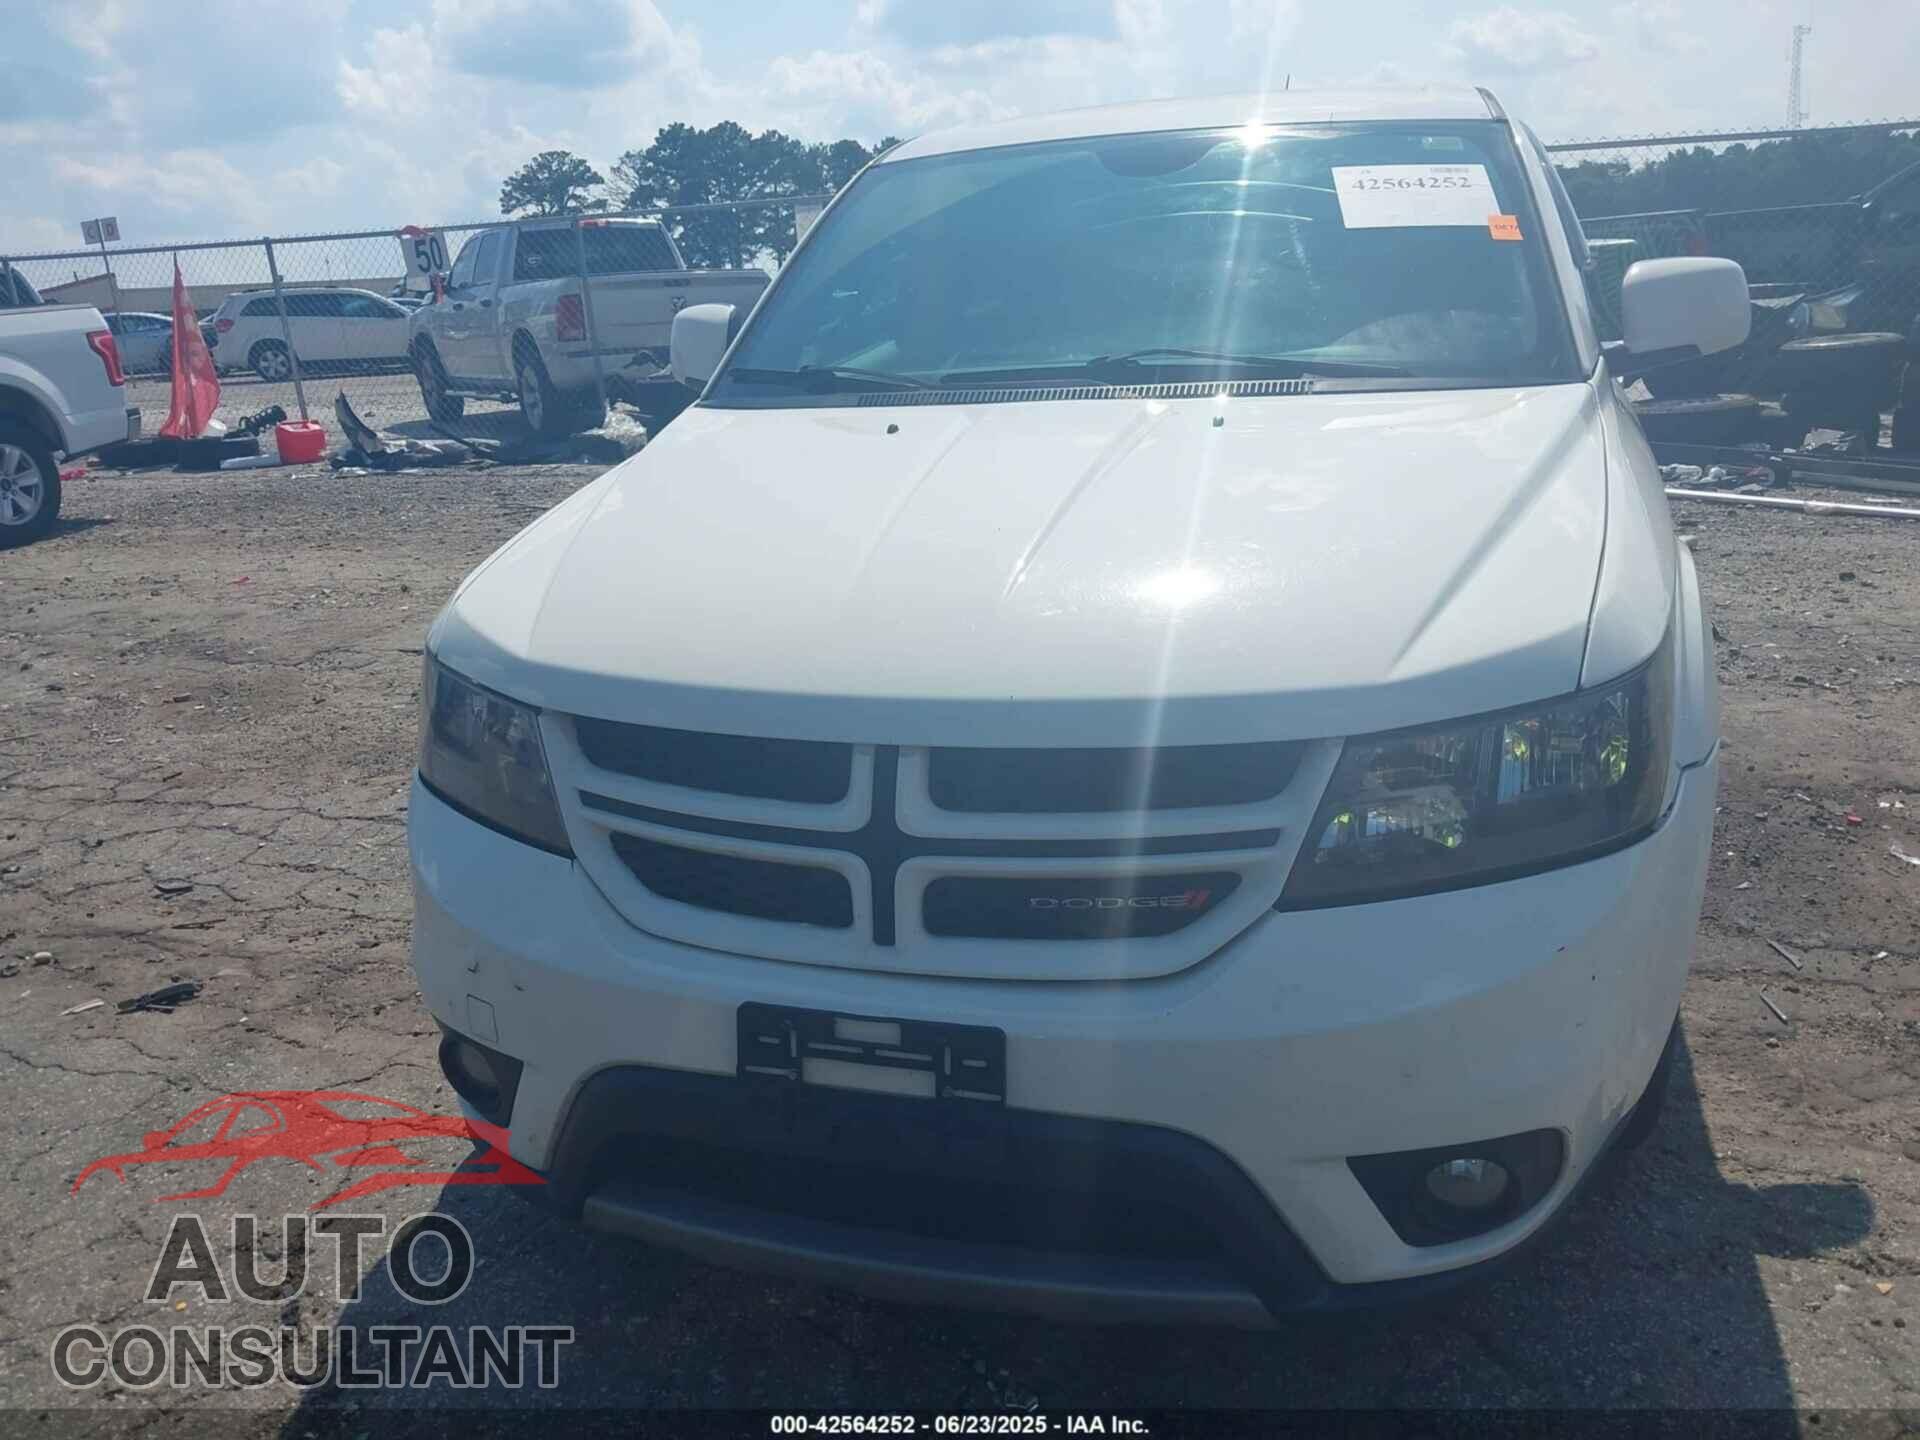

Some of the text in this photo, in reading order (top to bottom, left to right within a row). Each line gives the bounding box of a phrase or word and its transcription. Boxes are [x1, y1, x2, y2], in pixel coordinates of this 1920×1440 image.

[1352, 176, 1472, 190] 42564252
[415, 236, 443, 273] 50
[1028, 895, 1186, 909] DODGE
